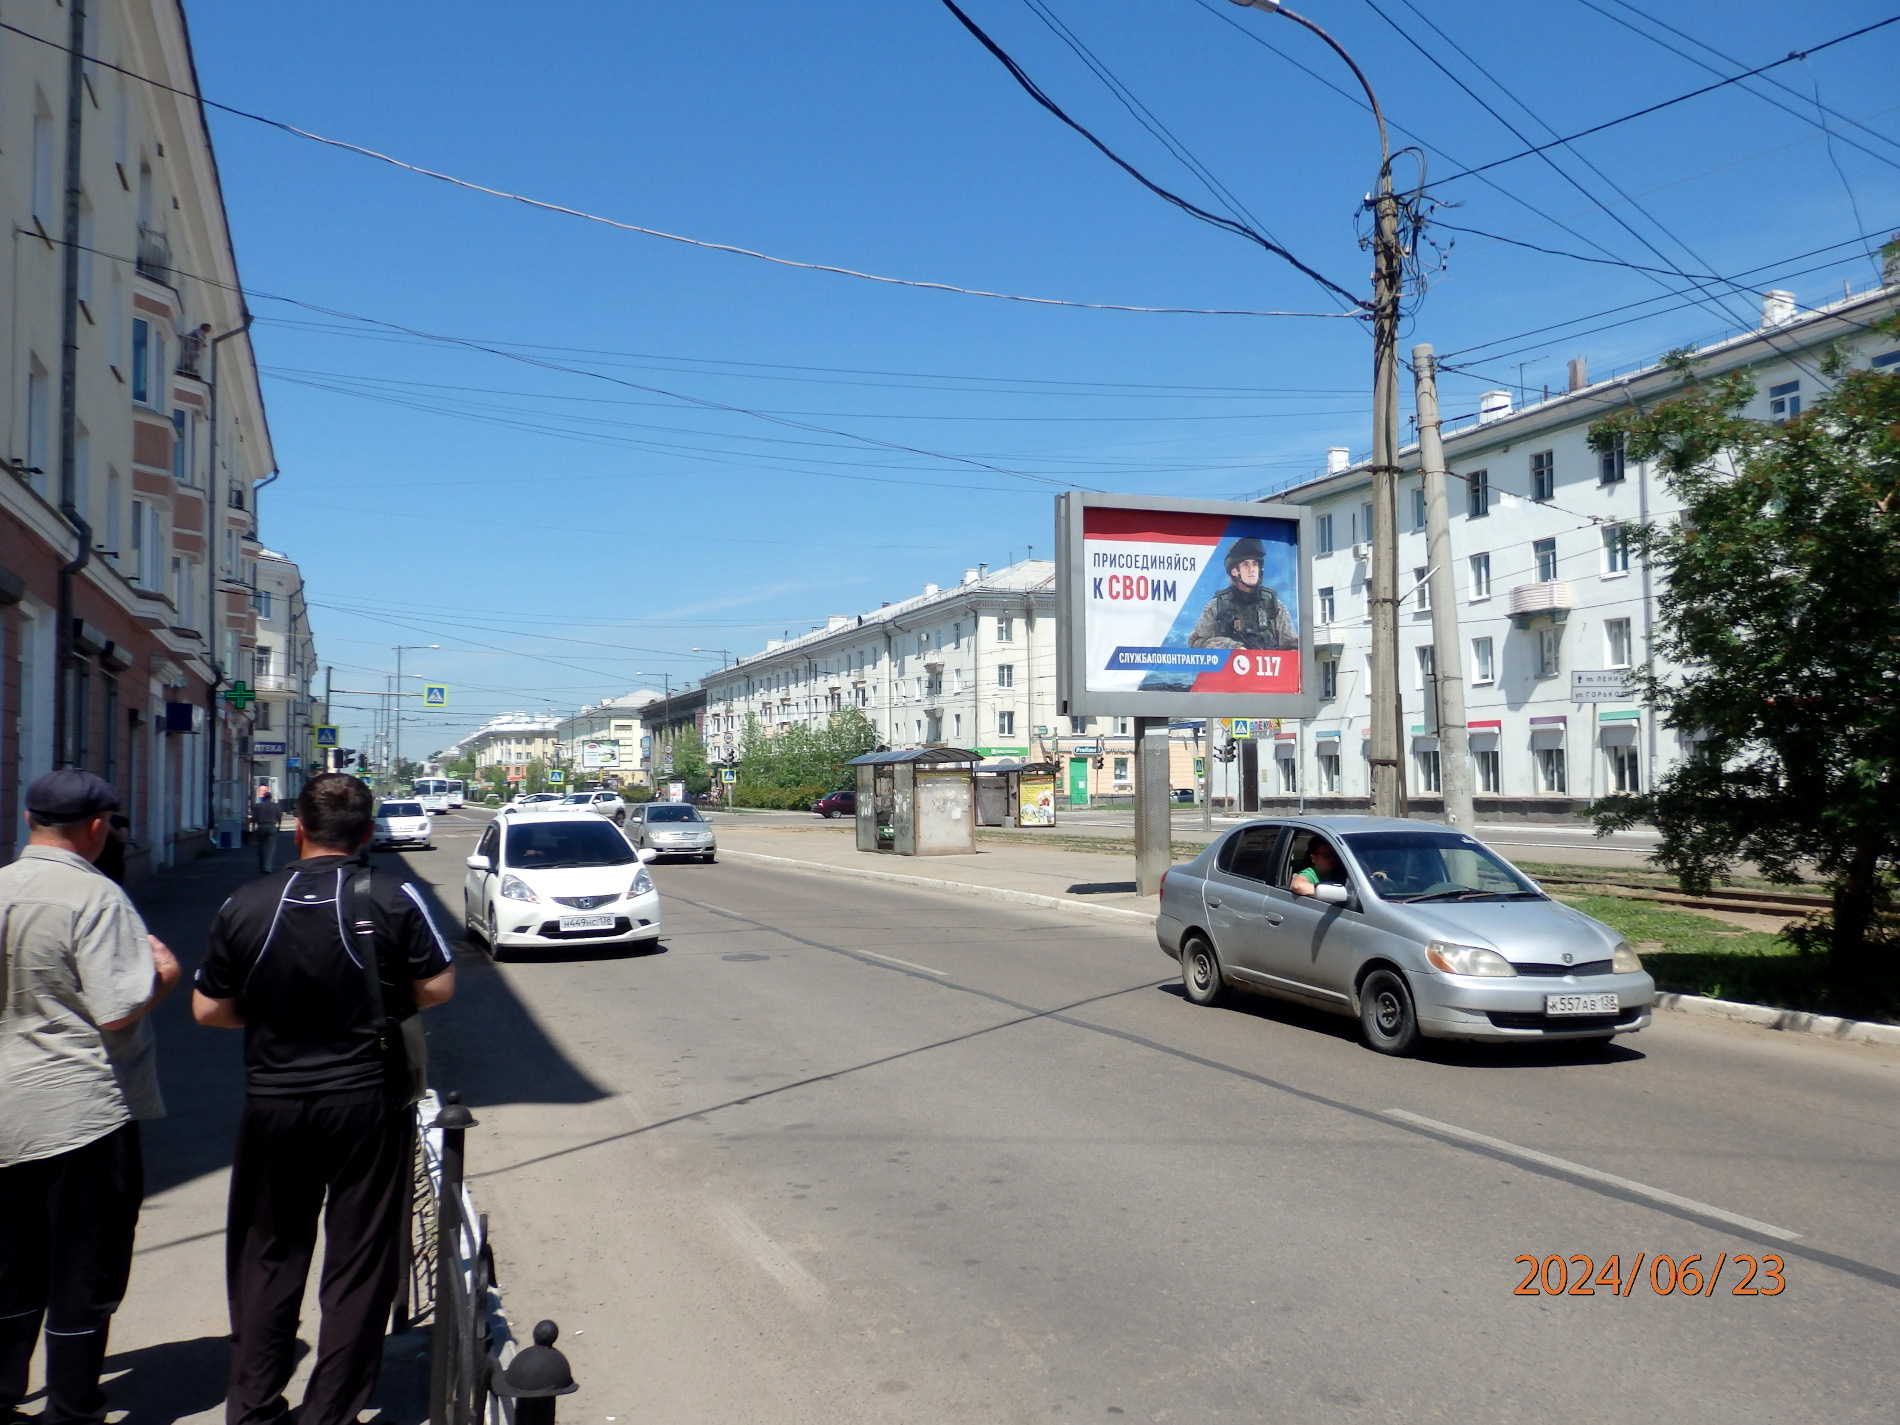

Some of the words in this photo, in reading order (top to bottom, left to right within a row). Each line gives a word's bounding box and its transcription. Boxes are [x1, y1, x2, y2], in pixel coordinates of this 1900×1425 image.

[1093, 553, 1196, 571] ПРИСОЕДИНЯЙСЯ
[1093, 577, 1103, 599] К
[1108, 574, 1177, 601] СВОИМ
[1118, 652, 1219, 666] СЛУЖБАПОКОНТРАКТУ.РФ
[1256, 656, 1281, 676] 117
[254, 744, 282, 752] ПТЕКА
